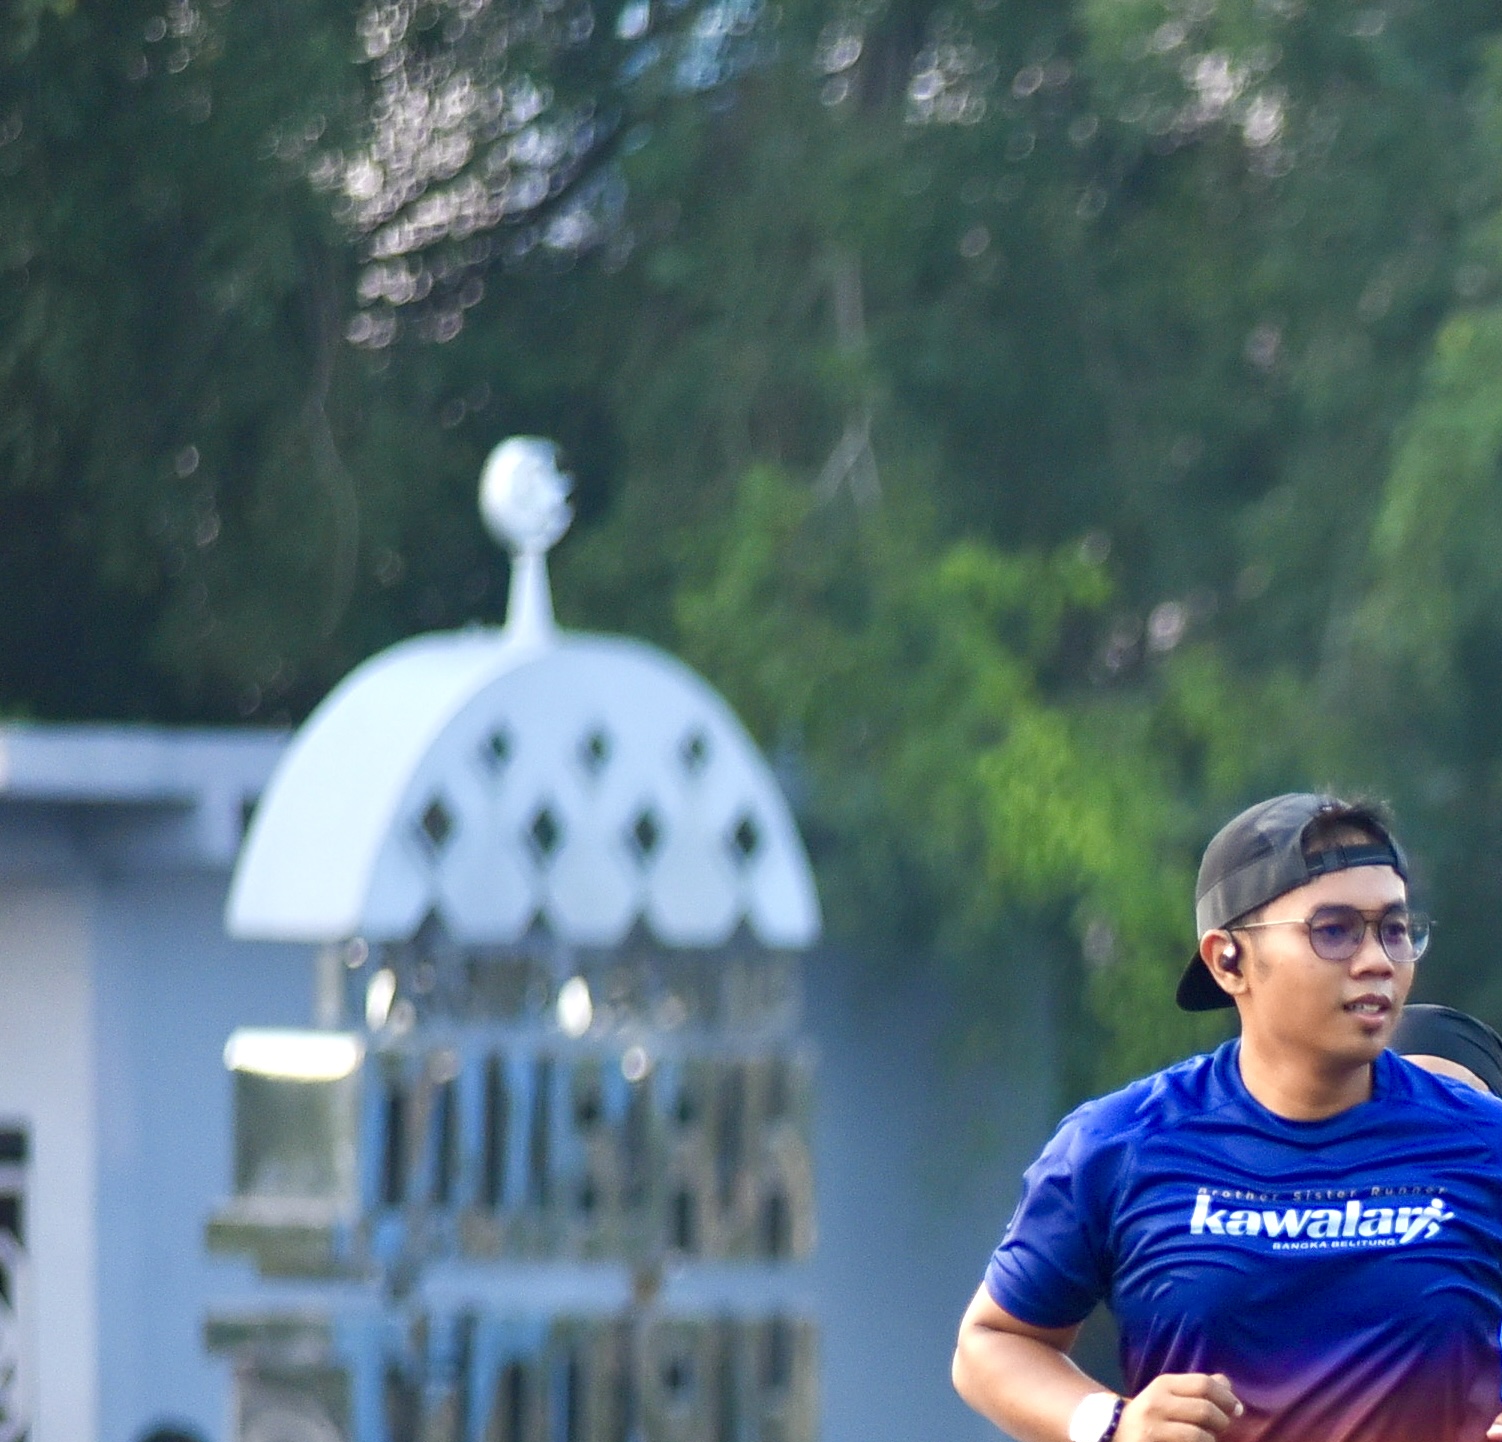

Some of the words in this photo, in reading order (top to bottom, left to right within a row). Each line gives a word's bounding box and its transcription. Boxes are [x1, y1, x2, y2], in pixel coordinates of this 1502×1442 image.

[1293, 1189, 1358, 1201] Sister
[1371, 1185, 1449, 1196] Runner
[1272, 1241, 1327, 1250] BANGKA
[1330, 1238, 1396, 1249] BELITUNG
